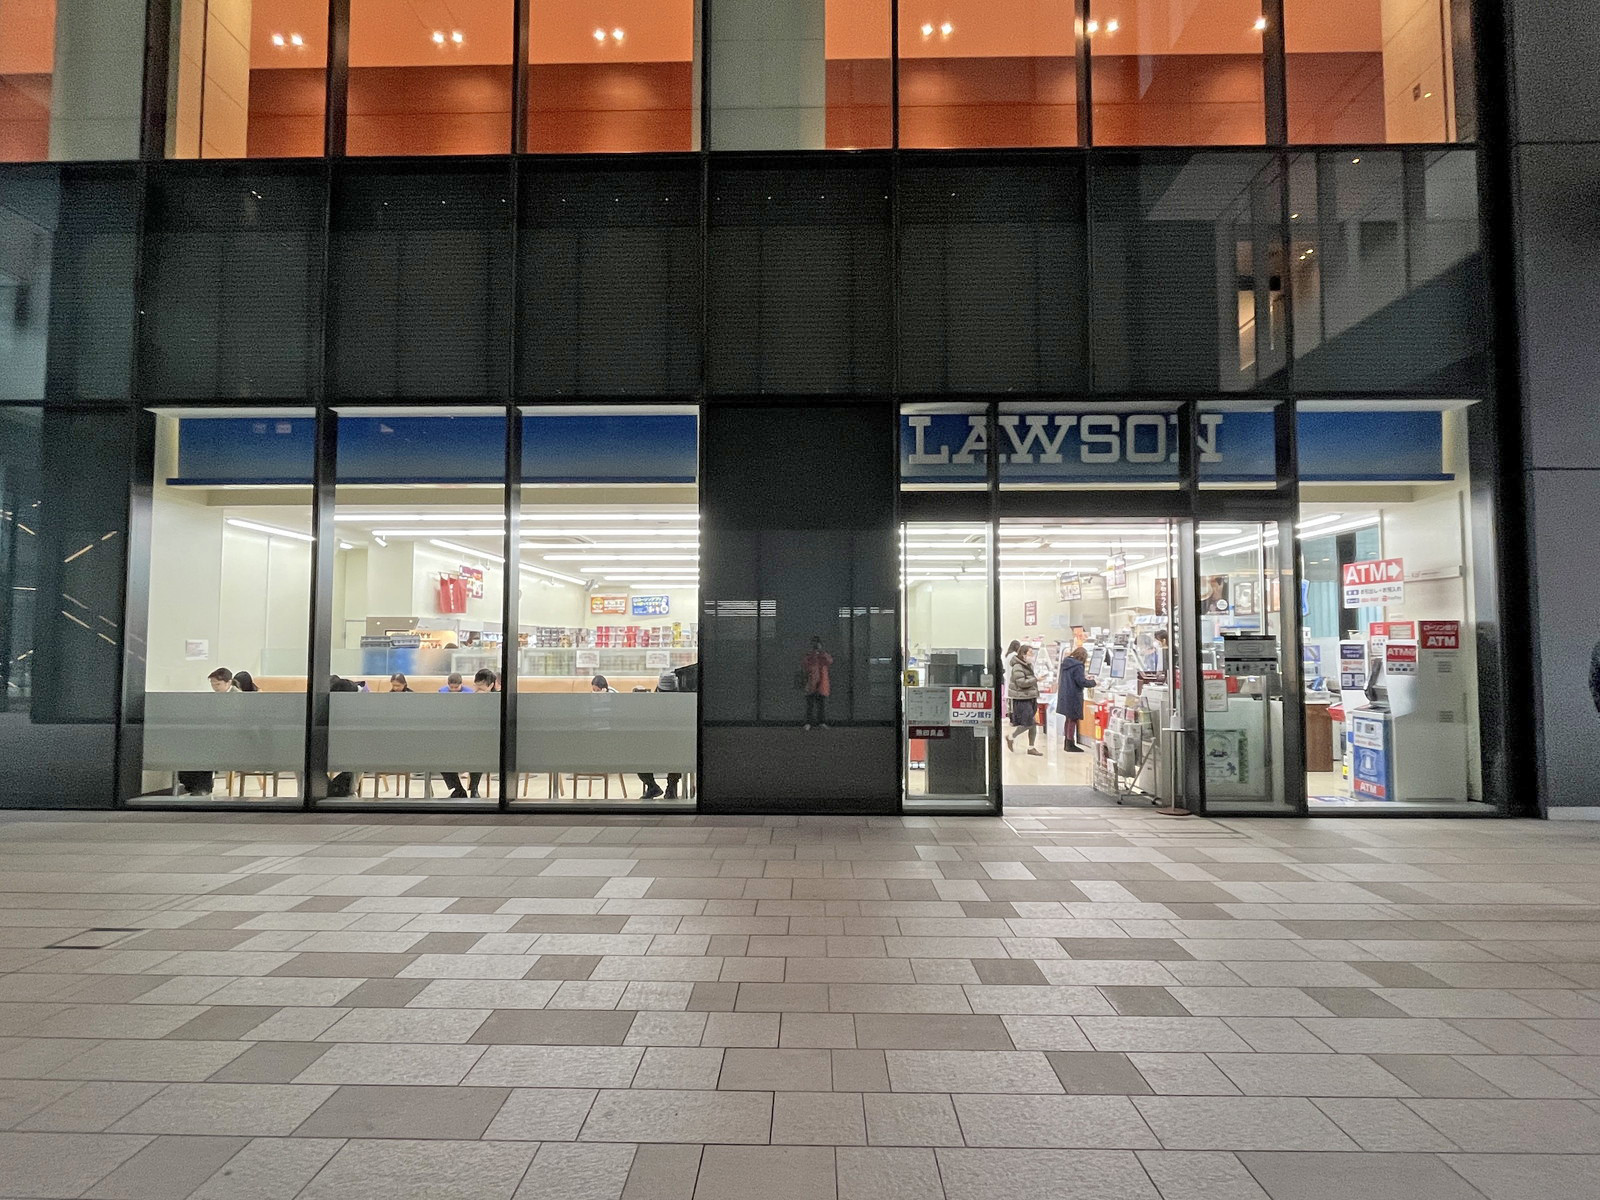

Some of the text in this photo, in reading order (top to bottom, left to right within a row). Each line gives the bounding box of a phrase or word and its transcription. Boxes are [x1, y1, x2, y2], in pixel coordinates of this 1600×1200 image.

[908, 415, 1223, 464] LAWSON
[1345, 562, 1387, 584] ATM
[1427, 635, 1456, 647] ATM
[957, 691, 987, 702] ATM
[952, 711, 992, 719] ローソン銀行
[1359, 781, 1377, 794] ATM
